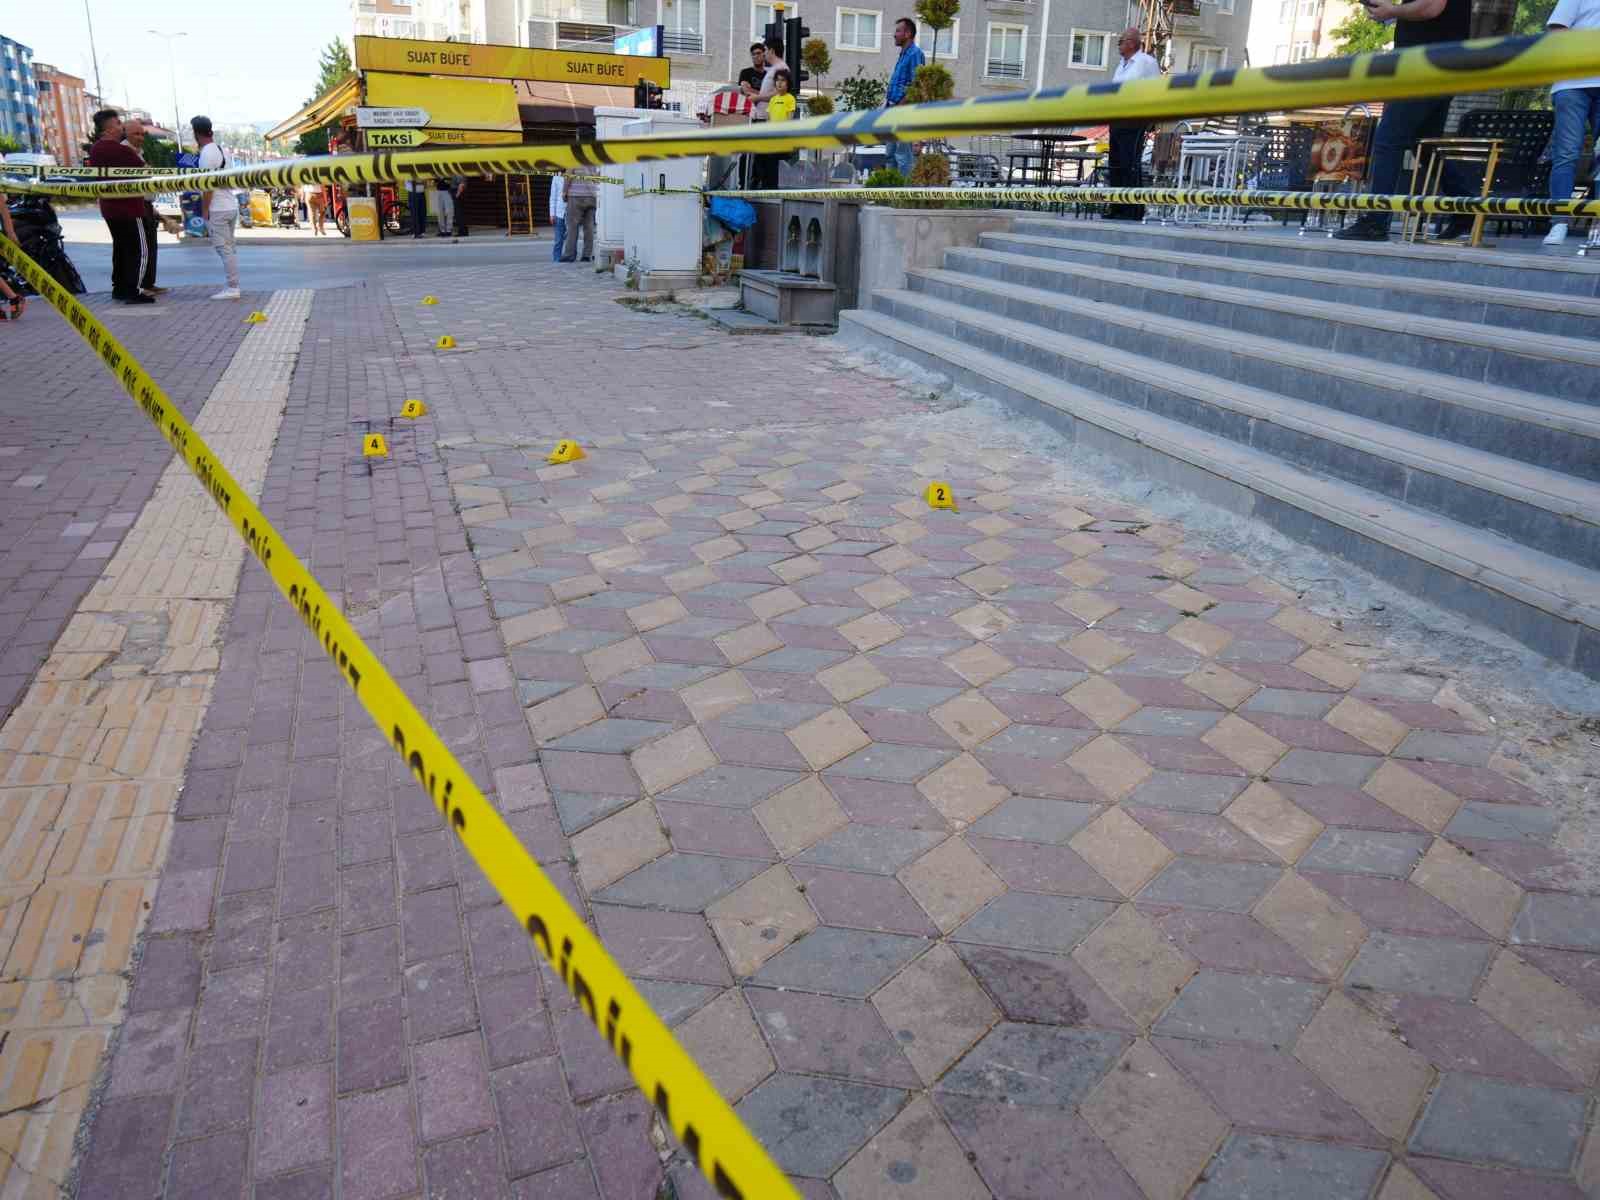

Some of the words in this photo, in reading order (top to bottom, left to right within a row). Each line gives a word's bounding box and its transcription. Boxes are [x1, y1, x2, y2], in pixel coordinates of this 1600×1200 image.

[407, 51, 437, 64] SUAT
[567, 62, 594, 74] SUAT
[372, 131, 412, 144] TAKSİ
[408, 403, 415, 412] 5
[371, 439, 378, 449] 4
[558, 444, 568, 454] 3
[936, 488, 945, 500] 2
